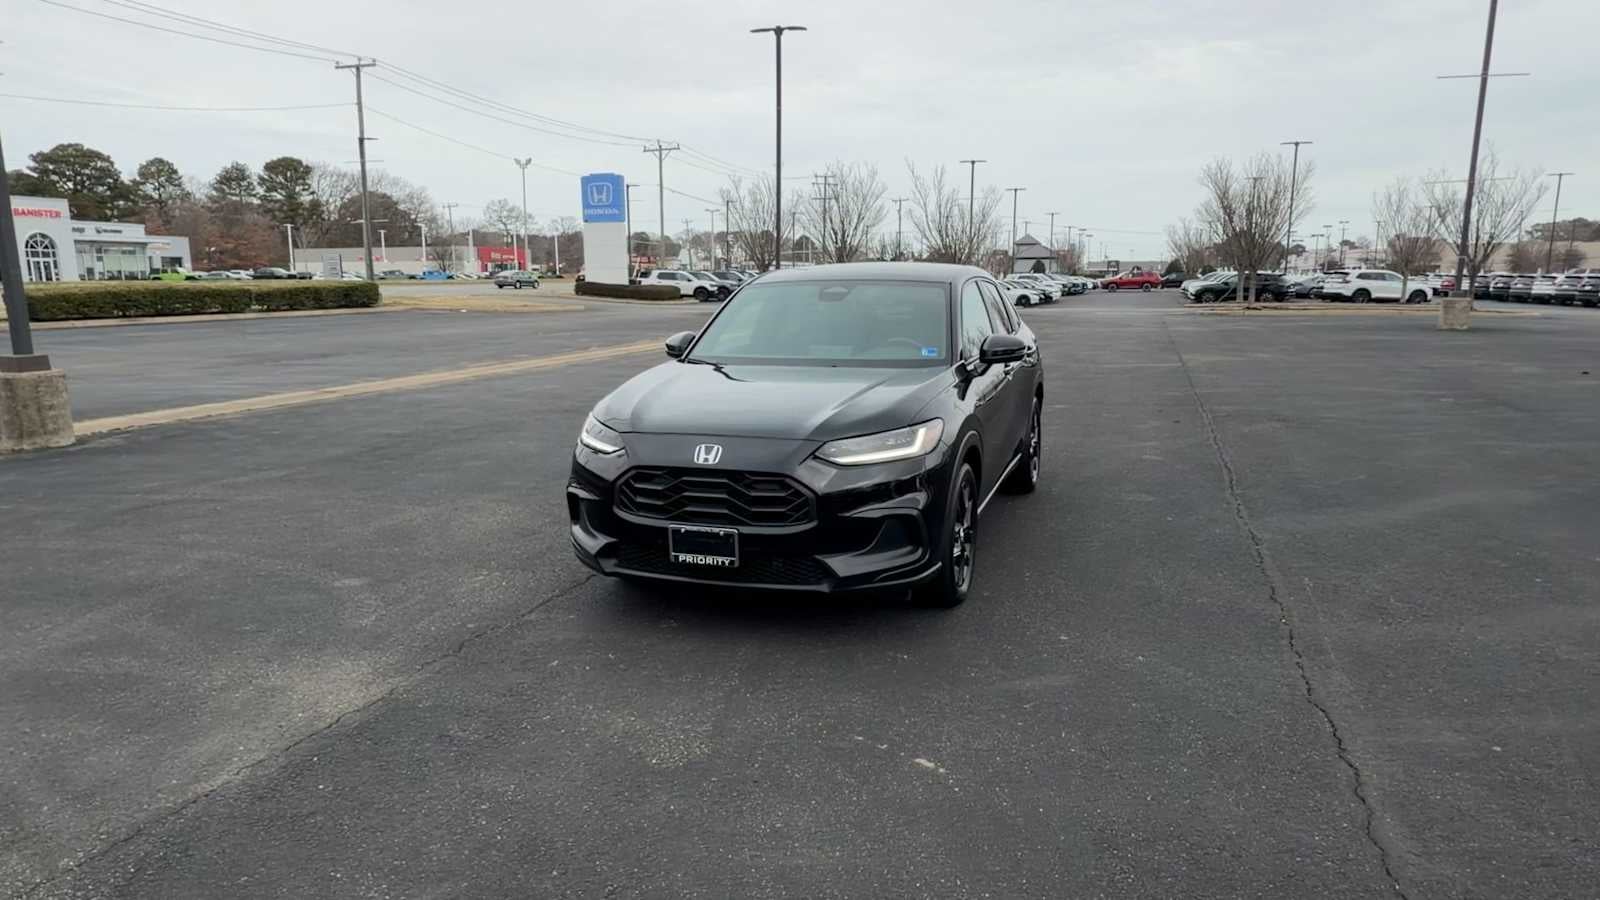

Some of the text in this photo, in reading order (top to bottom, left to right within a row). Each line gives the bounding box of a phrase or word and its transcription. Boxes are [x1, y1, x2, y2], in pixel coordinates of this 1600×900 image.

[13, 207, 62, 218] BANISTER
[584, 208, 619, 216] HONDA
[679, 555, 730, 567] PRIORITY
